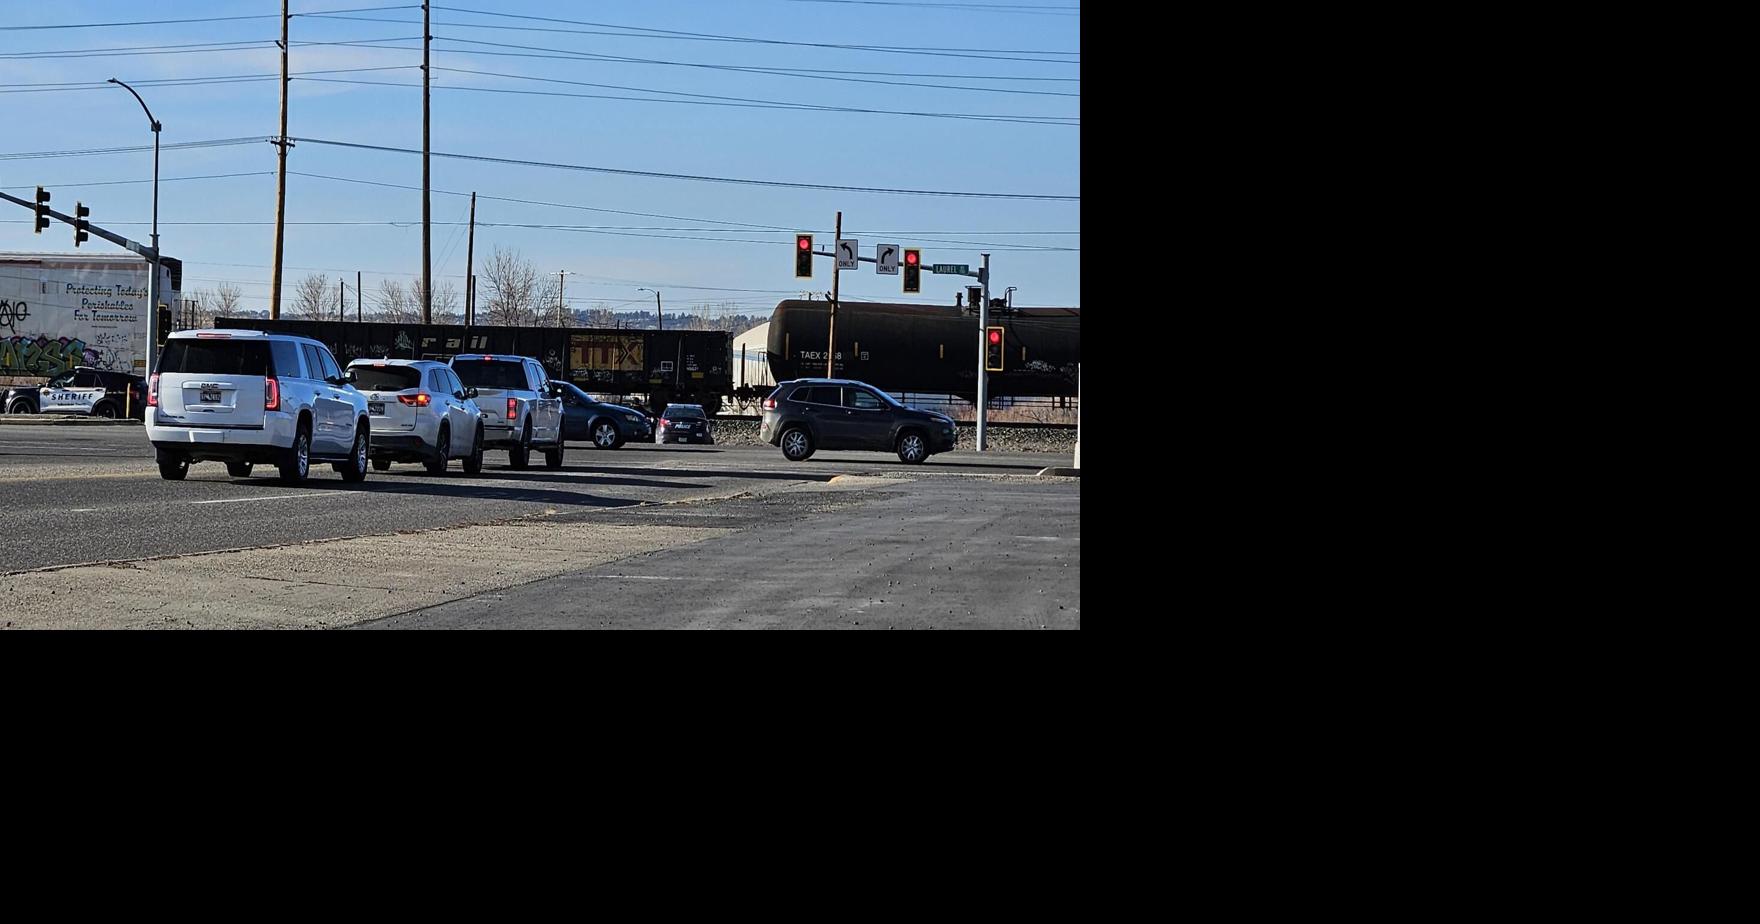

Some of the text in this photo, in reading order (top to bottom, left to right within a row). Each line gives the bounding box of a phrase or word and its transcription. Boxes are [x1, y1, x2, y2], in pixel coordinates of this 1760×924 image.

[934, 265, 957, 273] LAUREL
[65, 283, 148, 299] Protecting Today's
[81, 297, 134, 311] Perishables
[73, 309, 138, 322] For Tomorrow
[421, 335, 488, 349] rail
[574, 340, 640, 365] TTX
[800, 351, 821, 359] TAEX
